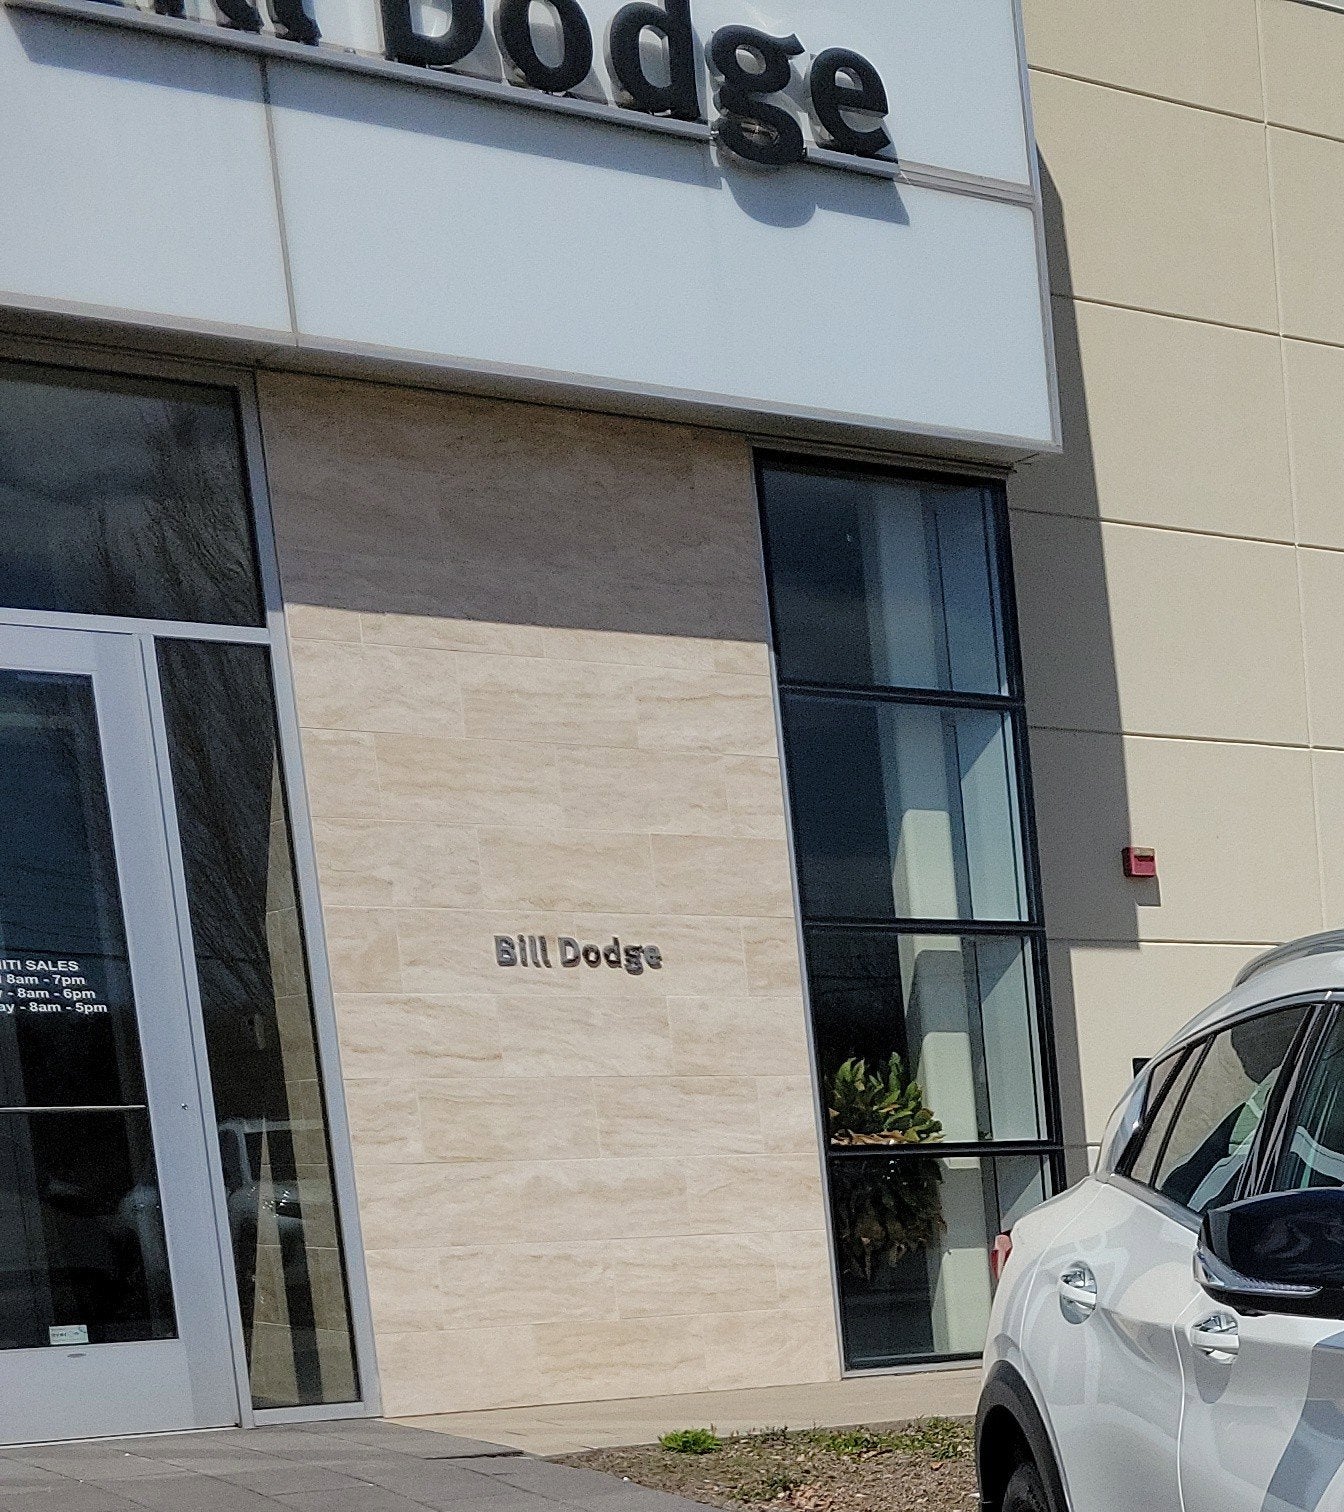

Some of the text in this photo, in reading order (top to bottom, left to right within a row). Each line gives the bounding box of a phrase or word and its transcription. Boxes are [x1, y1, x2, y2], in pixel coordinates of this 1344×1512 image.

[493, 934, 663, 976] Bill Dodge
[25, 960, 80, 972] SALES
[6, 974, 39, 985] 8am
[52, 974, 86, 987] 7pm
[17, 988, 50, 998] 8am
[63, 989, 96, 1001] 6pm
[29, 1002, 61, 1013] 8am
[75, 1002, 108, 1015] 5pm
